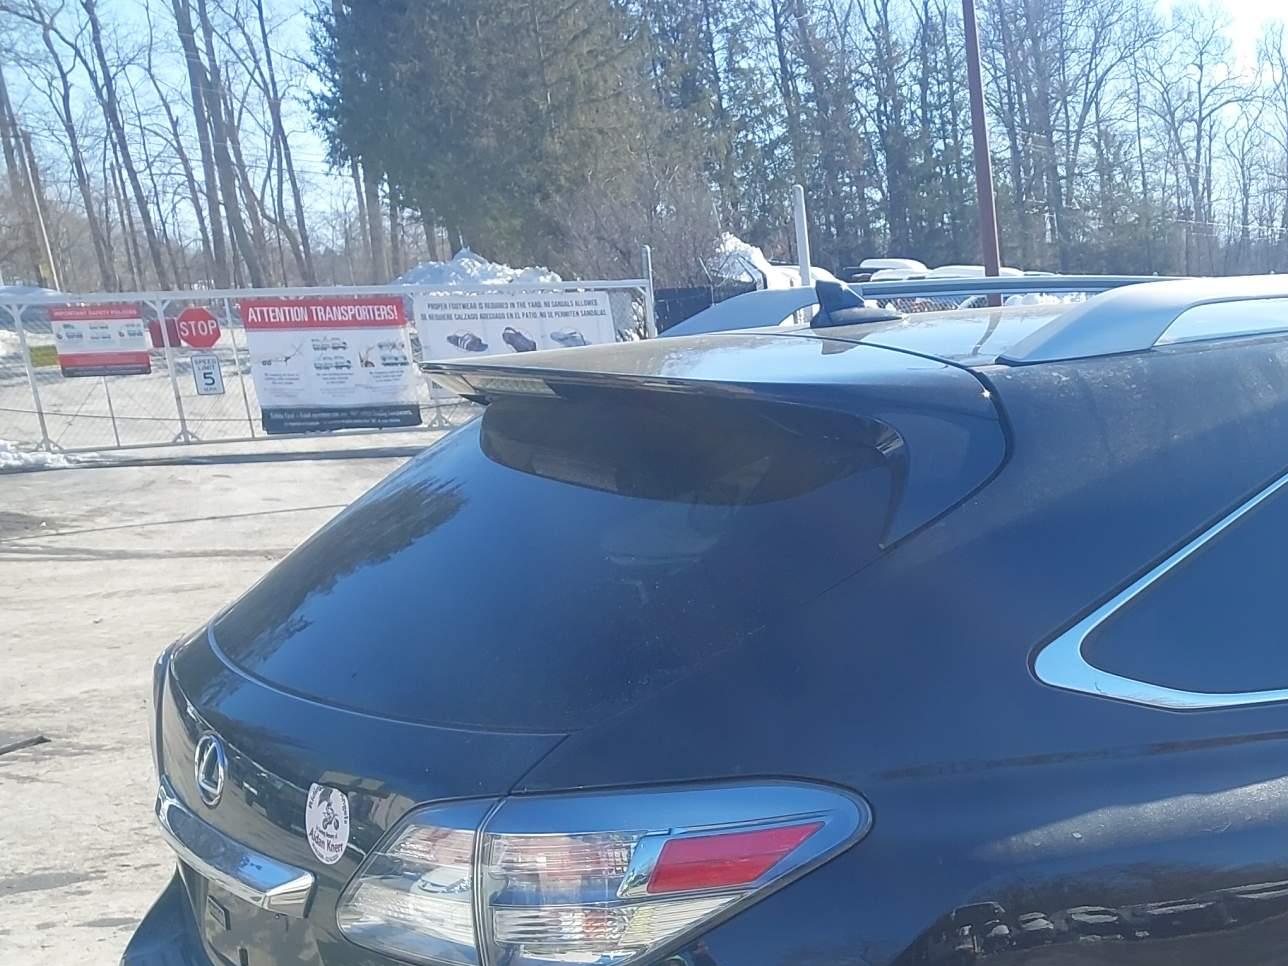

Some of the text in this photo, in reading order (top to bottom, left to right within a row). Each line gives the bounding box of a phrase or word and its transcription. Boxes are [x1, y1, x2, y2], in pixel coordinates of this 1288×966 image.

[248, 303, 398, 323] ATTENTION TRANSPORTERS!
[179, 319, 217, 337] STOP
[203, 371, 216, 386] 5
